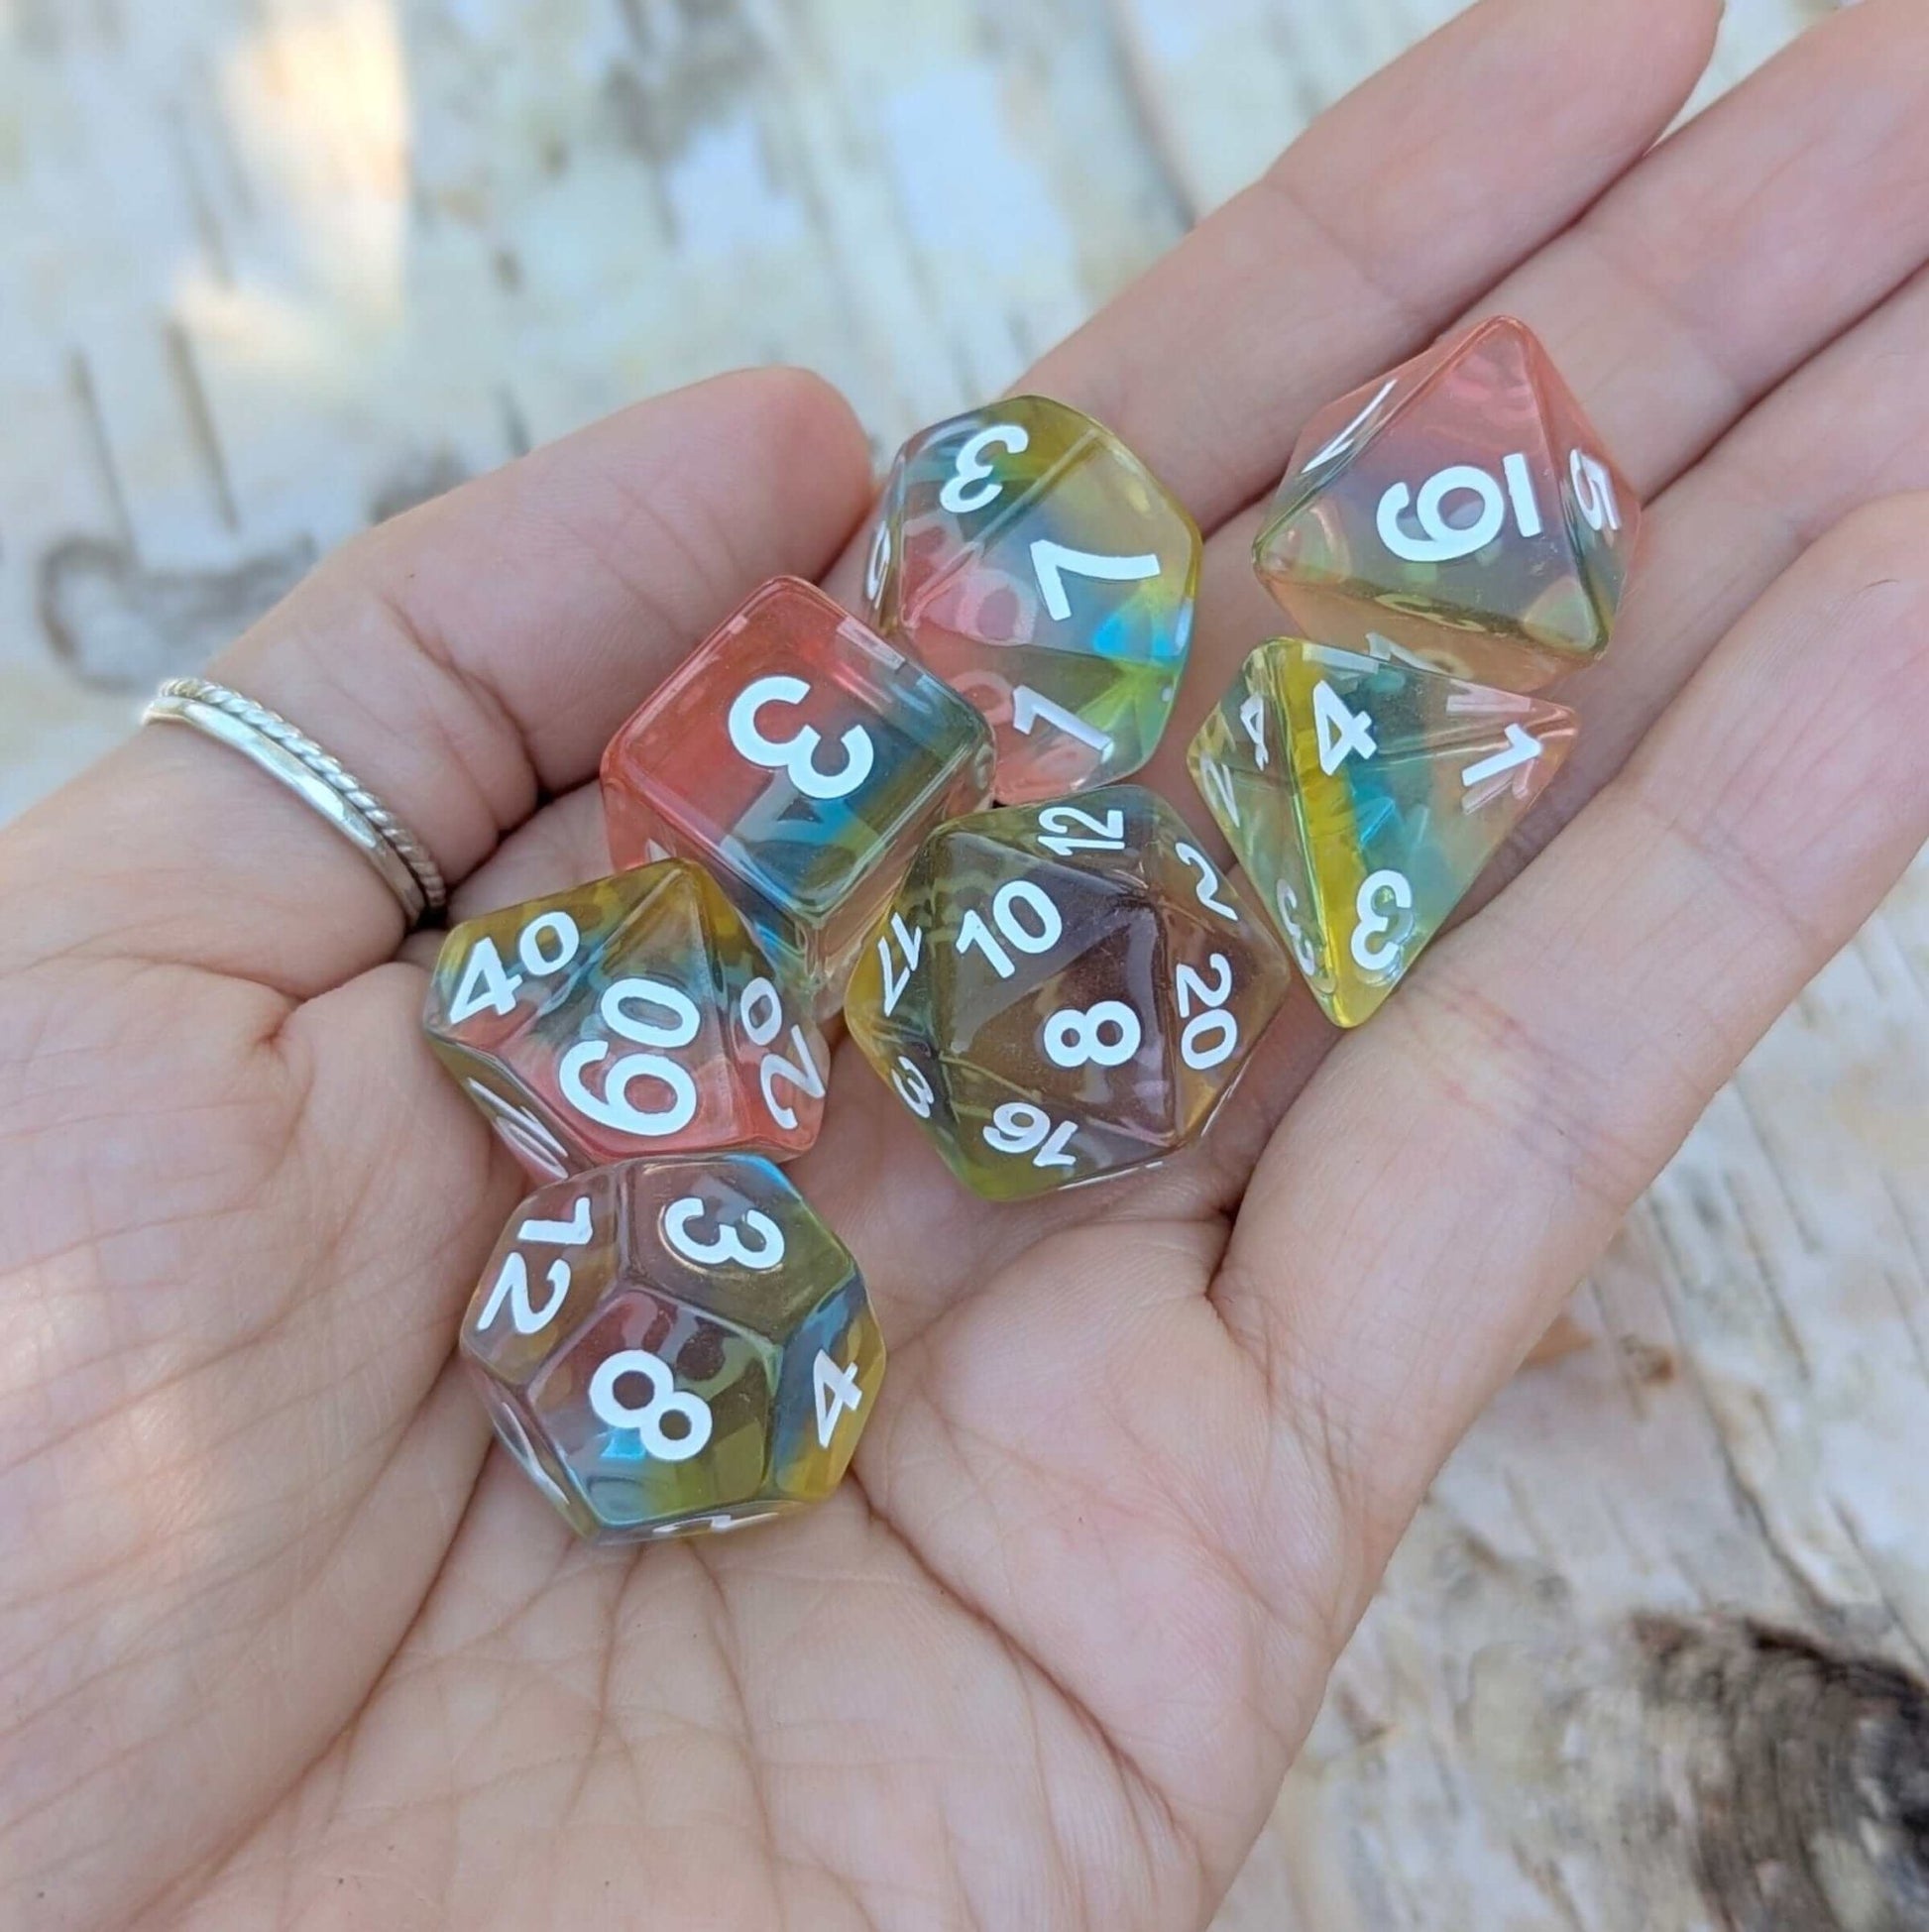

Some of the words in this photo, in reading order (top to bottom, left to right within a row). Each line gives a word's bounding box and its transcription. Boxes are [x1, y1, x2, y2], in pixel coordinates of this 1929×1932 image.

[940, 424, 1029, 513] 3
[1569, 448, 1620, 530] 5
[1030, 539, 1161, 621] 7
[728, 676, 873, 798] 3
[1012, 685, 1114, 762] 1
[1312, 680, 1377, 775] 4
[1462, 724, 1542, 786] 1
[1038, 807, 1124, 855] 12
[956, 880, 1062, 978] 10
[1175, 843, 1238, 921] 2
[1351, 870, 1412, 969] 3
[449, 911, 579, 1025] 40
[877, 912, 922, 1017] 17
[1176, 953, 1237, 1070] 20
[558, 977, 700, 1137] 60
[739, 976, 826, 1130] 20
[1044, 1000, 1141, 1068] 8
[892, 1056, 934, 1118] 3
[982, 1102, 1078, 1167] 16
[477, 1196, 593, 1334] 12
[665, 1197, 785, 1270] 3
[589, 1349, 713, 1461] 8
[813, 1349, 862, 1448] 4
